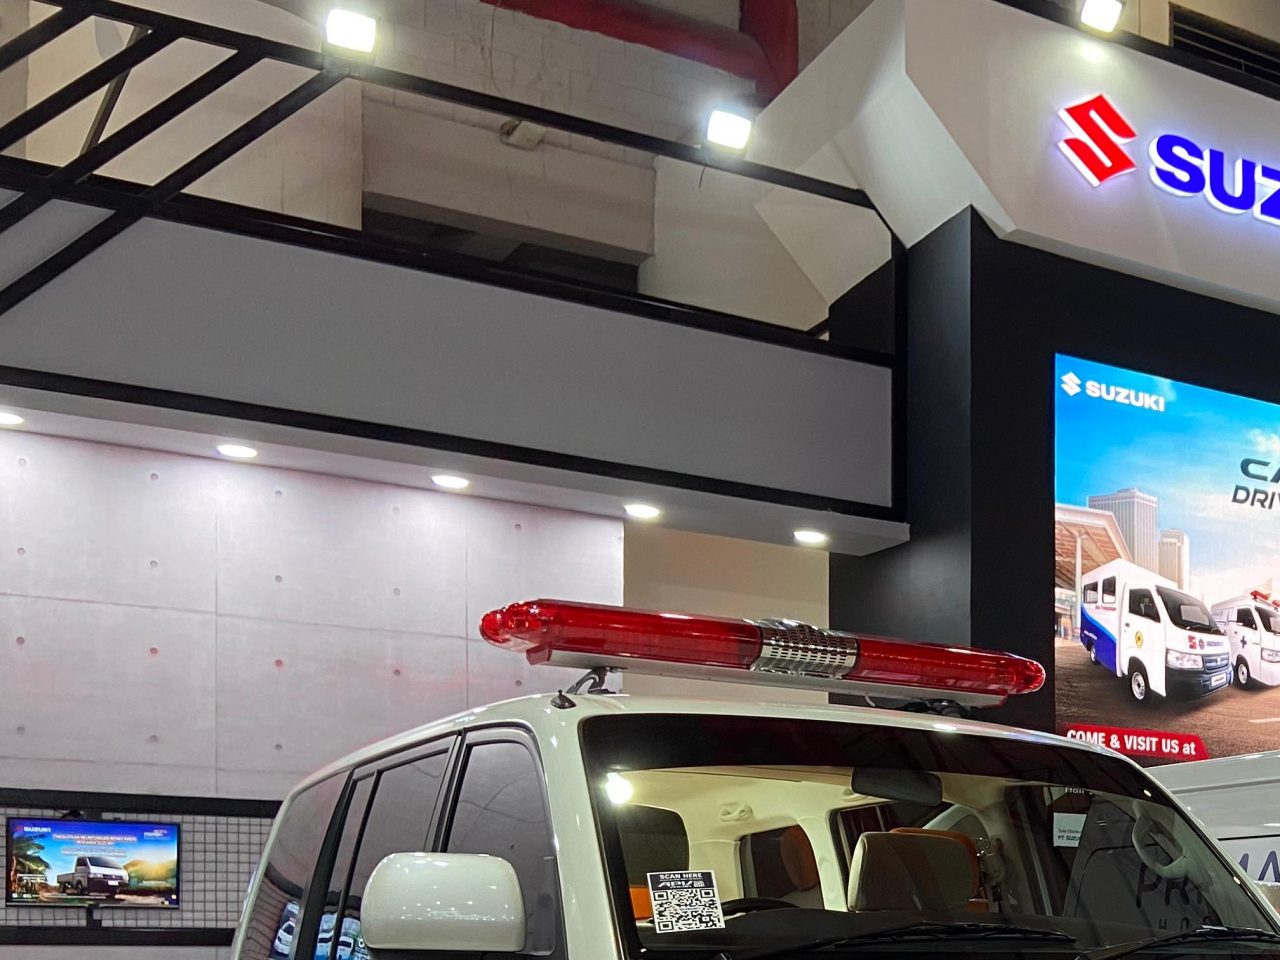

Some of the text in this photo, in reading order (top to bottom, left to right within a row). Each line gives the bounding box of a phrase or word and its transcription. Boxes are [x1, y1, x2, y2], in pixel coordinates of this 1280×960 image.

[1085, 380, 1165, 412] SUZUKI
[1067, 729, 1196, 756] COME & VISIT US at
